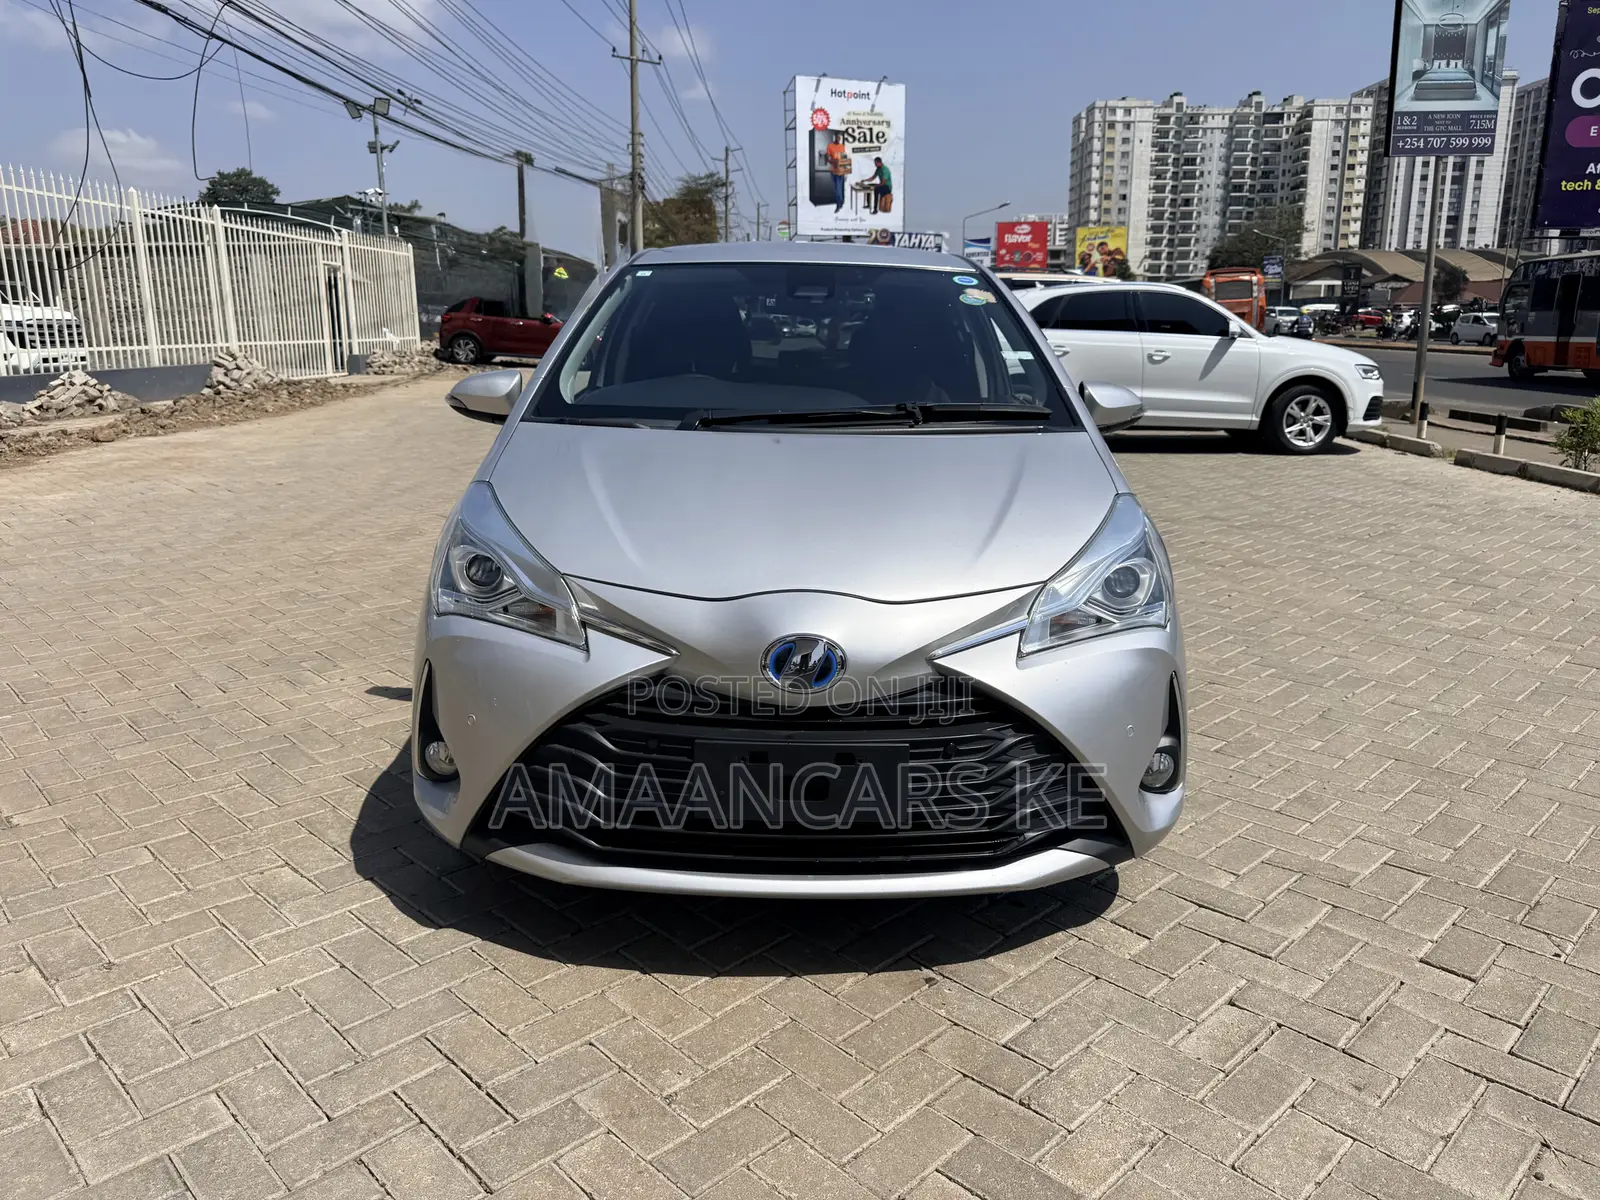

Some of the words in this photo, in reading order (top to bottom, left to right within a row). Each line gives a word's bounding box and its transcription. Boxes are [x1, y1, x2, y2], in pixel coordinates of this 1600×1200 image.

[831, 88, 871, 101] Hotpoint
[840, 117, 891, 128] Anniversary
[1469, 119, 1495, 130] 7.15M
[845, 126, 888, 144] Sale
[1397, 138, 1424, 149] +254
[1427, 137, 1447, 148] 707
[1449, 137, 1469, 148] 599
[1471, 136, 1492, 148] 999
[1561, 179, 1592, 191] tech
[894, 232, 936, 249] YAHYA
